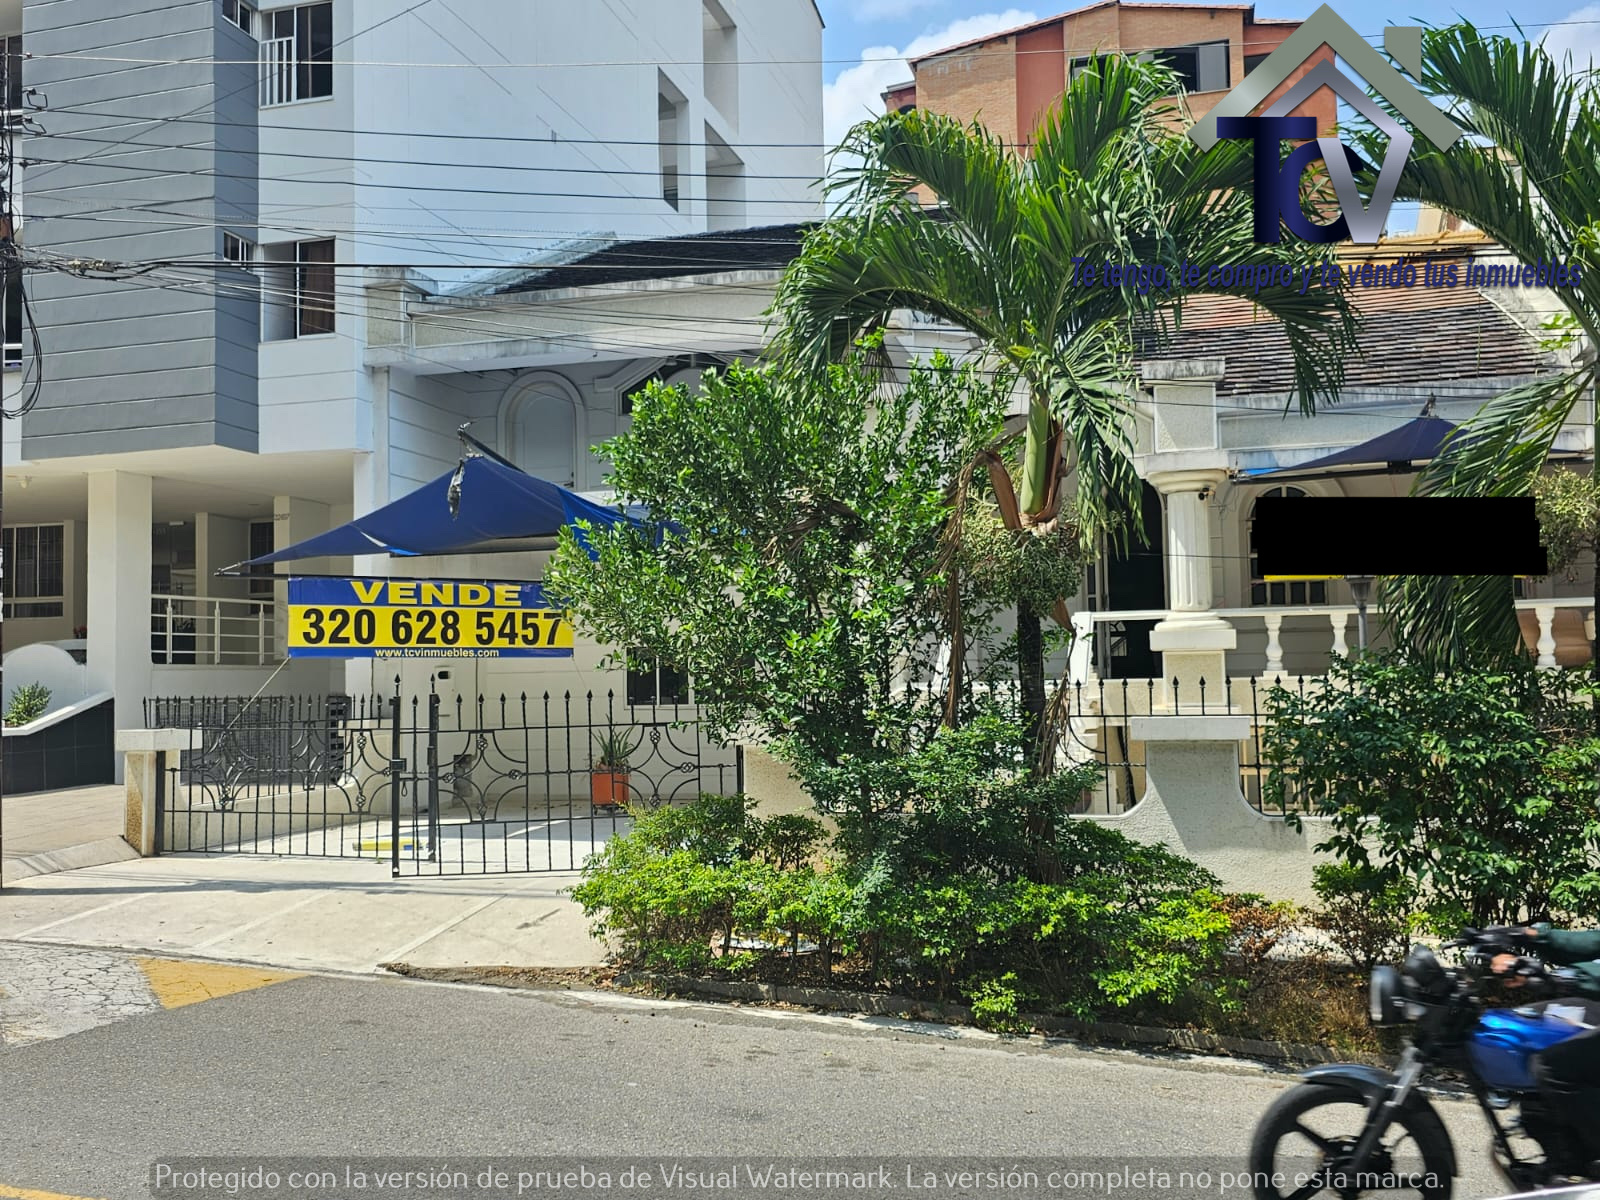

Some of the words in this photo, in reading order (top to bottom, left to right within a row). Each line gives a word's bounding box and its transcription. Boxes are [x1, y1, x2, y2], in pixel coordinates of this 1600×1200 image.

[351, 582, 522, 605] VENDE
[302, 608, 376, 645] 320
[391, 609, 461, 645] 628
[475, 611, 562, 646] 5457
[375, 648, 499, 658] www.tcvinmuebles.com
